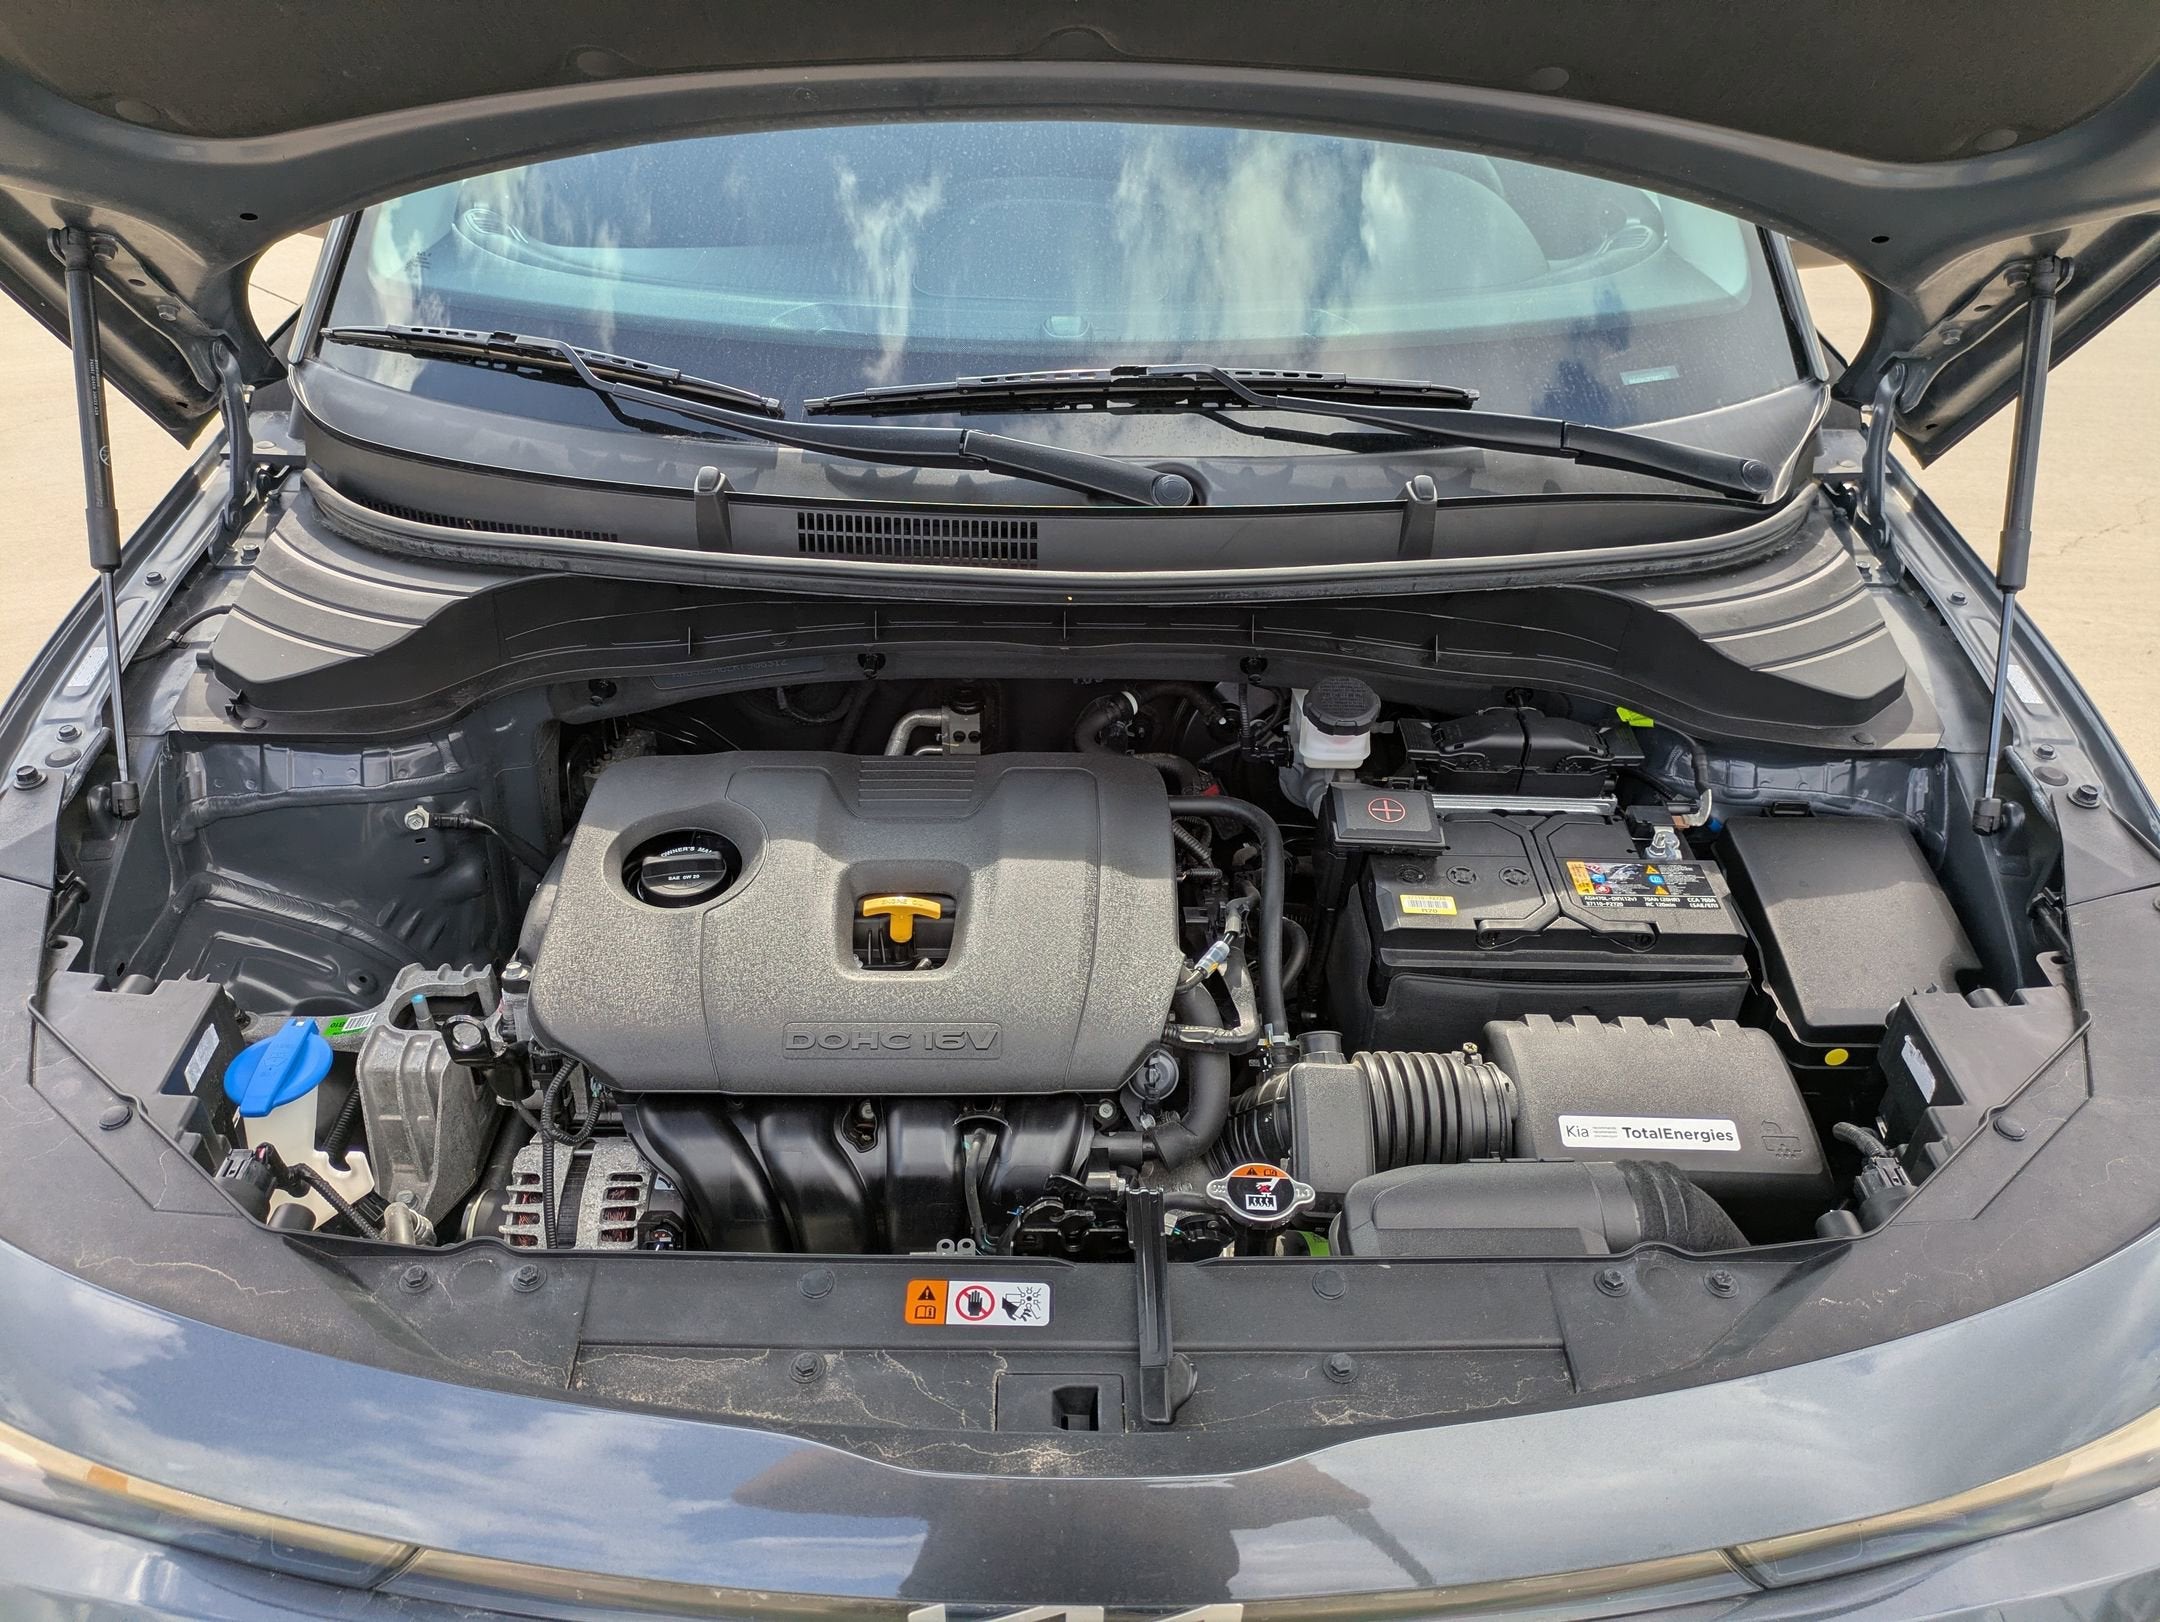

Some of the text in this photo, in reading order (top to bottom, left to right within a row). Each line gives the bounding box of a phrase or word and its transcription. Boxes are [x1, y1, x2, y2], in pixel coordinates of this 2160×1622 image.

[785, 1030, 998, 1050] DOHC 16V
[1566, 1125, 1734, 1143] Kia TotalEnergies
